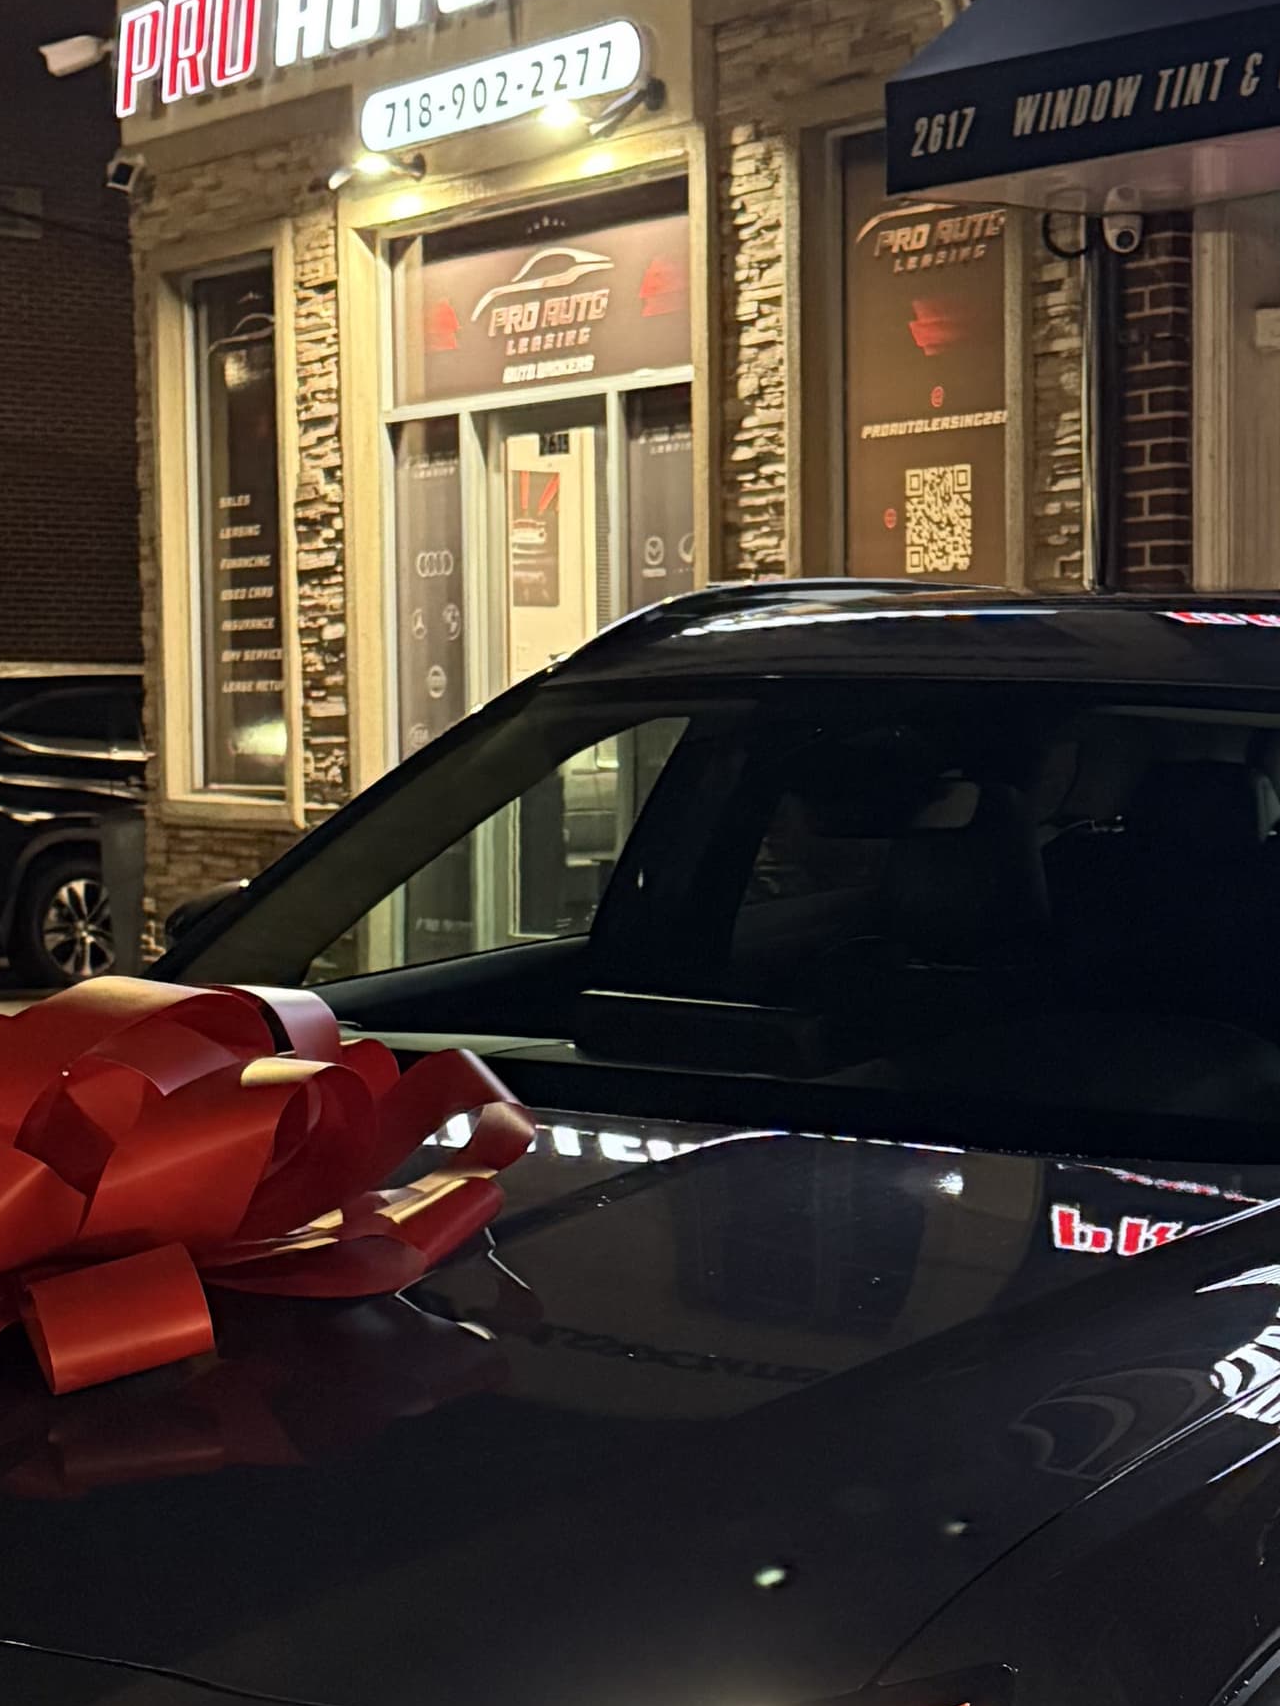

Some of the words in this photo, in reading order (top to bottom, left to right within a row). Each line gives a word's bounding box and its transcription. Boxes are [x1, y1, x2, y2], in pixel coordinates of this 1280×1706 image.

[383, 39, 615, 141] 718-902-2277
[911, 107, 976, 157] 2617
[1012, 74, 1144, 137] WINDOW
[1154, 57, 1228, 113] TINT
[874, 224, 929, 257] PRO
[488, 302, 540, 337] PRO
[542, 290, 609, 328] AUTO
[505, 327, 592, 357] LEASING
[220, 525, 261, 540] LEASING
